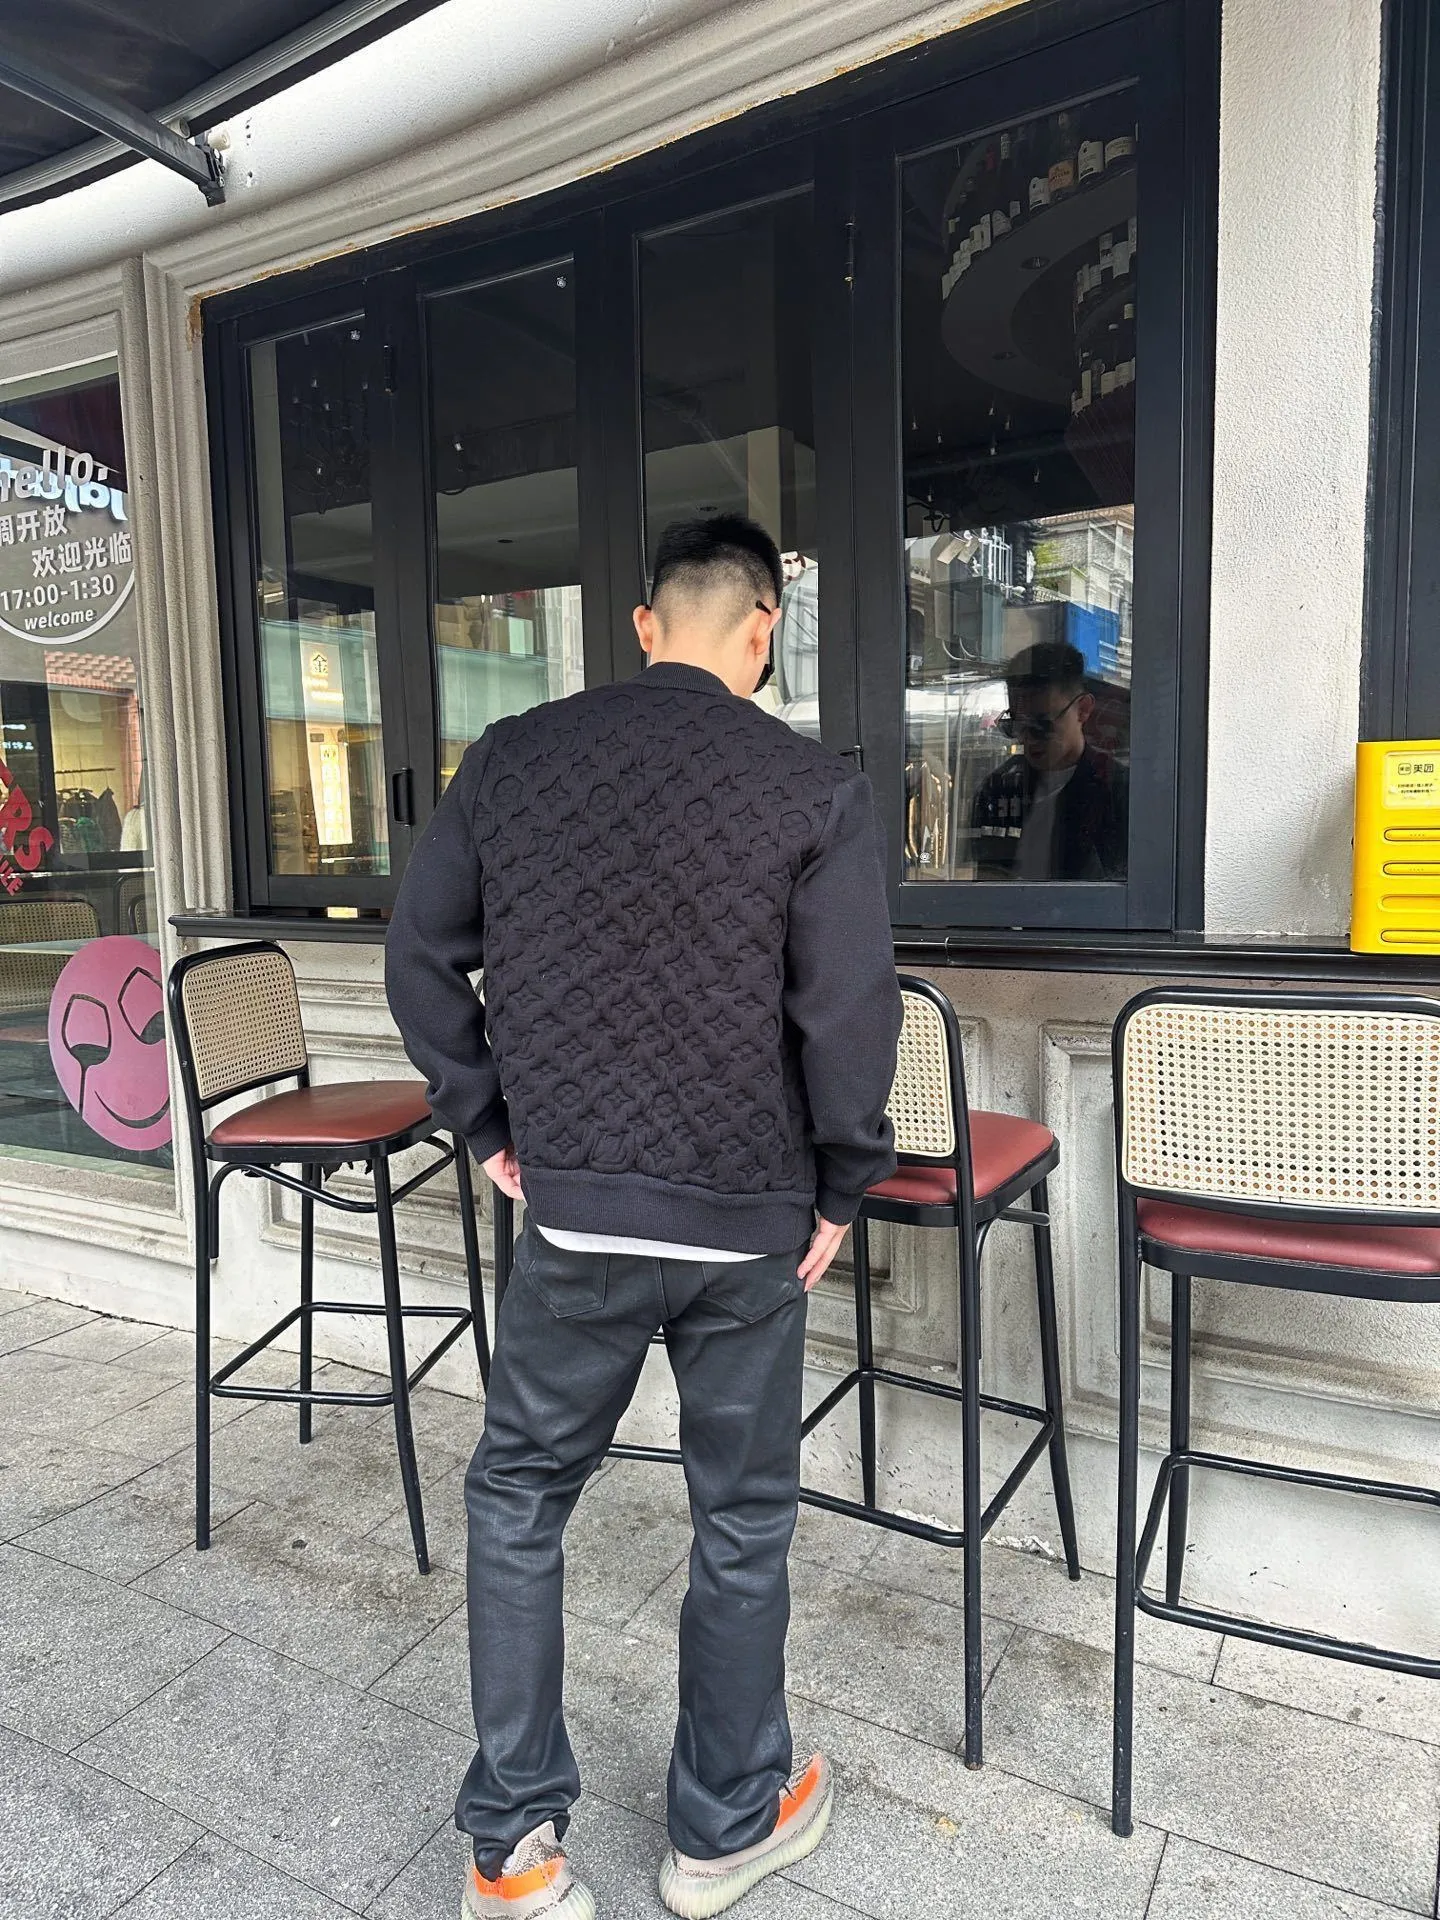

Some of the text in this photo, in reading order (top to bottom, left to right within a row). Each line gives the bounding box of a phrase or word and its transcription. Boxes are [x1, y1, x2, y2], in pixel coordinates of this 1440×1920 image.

[0, 504, 68, 546] 周开放
[32, 531, 132, 578] 欢迎光临
[0, 573, 115, 611] 17:00-1:30
[25, 609, 94, 630] welcome
